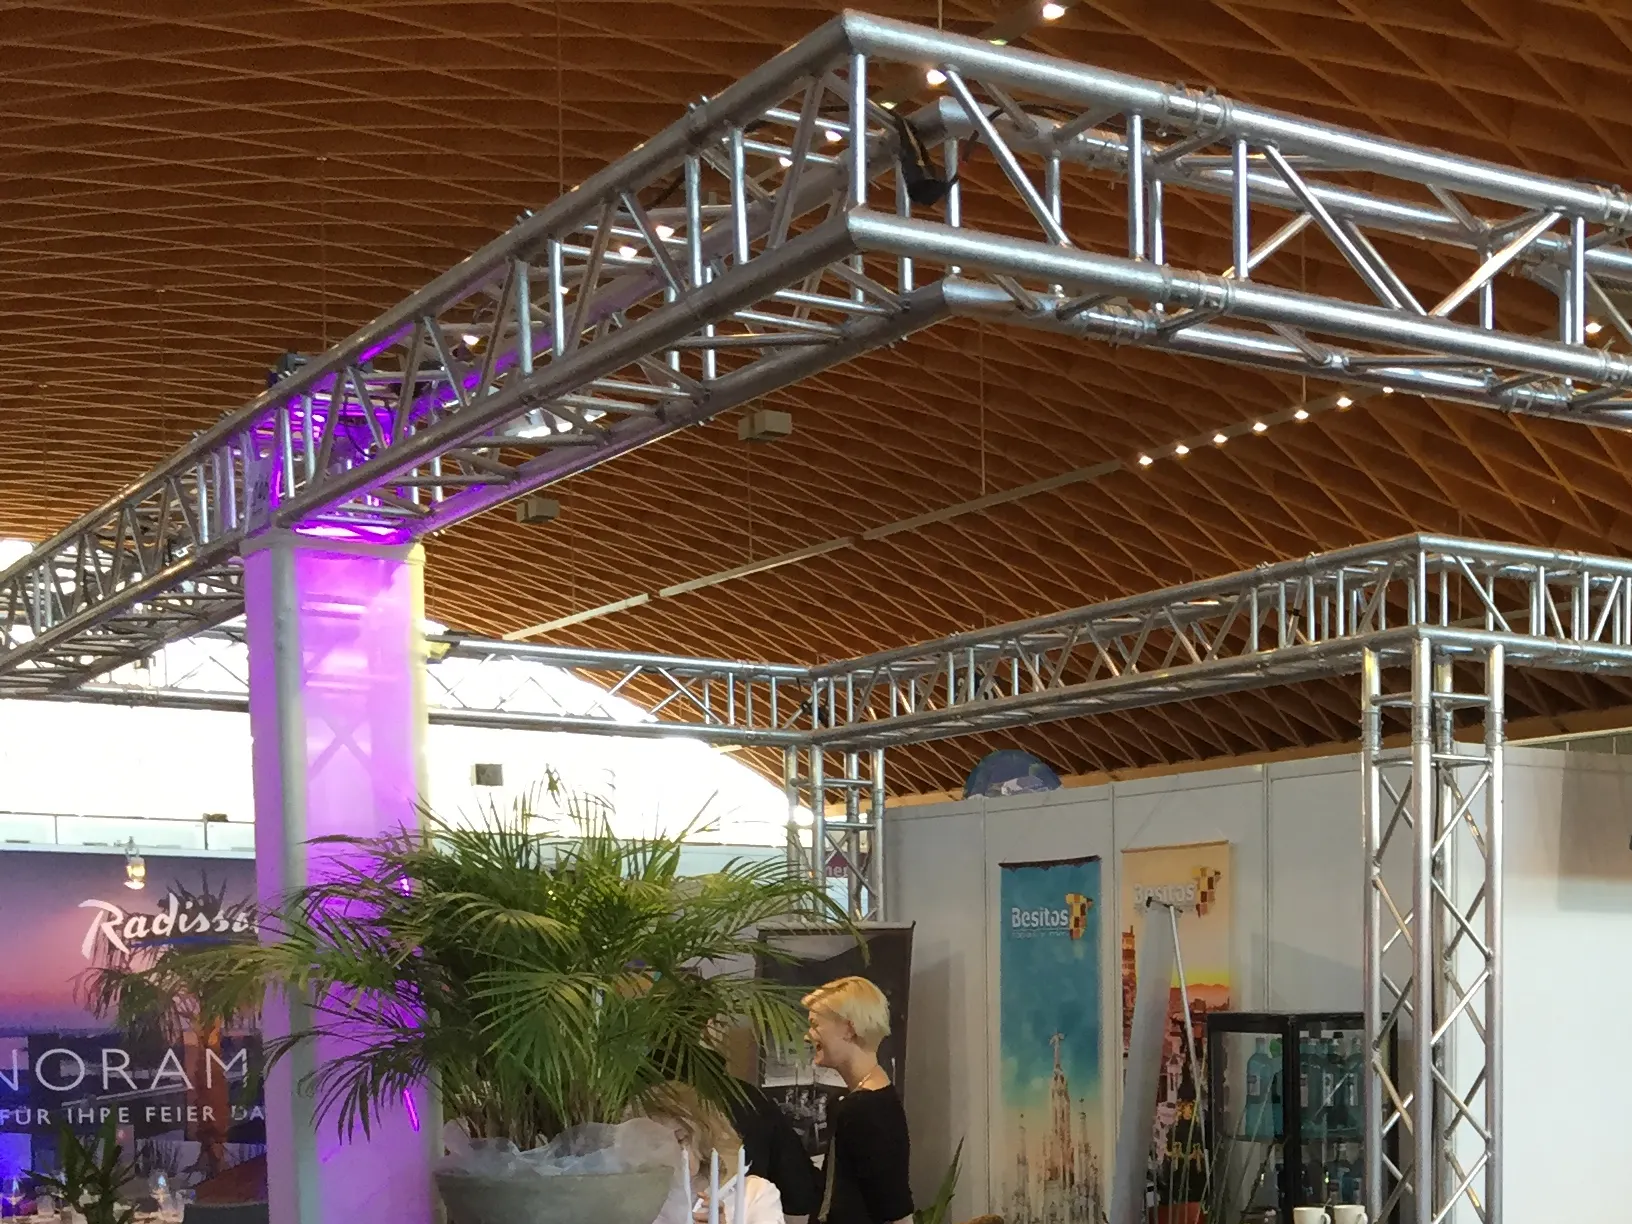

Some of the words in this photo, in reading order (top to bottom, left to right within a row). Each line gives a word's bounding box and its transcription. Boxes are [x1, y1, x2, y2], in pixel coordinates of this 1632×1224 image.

[1011, 907, 1069, 928] Besitos
[0, 1104, 52, 1125] FÜR
[145, 1105, 216, 1123] FEIER
